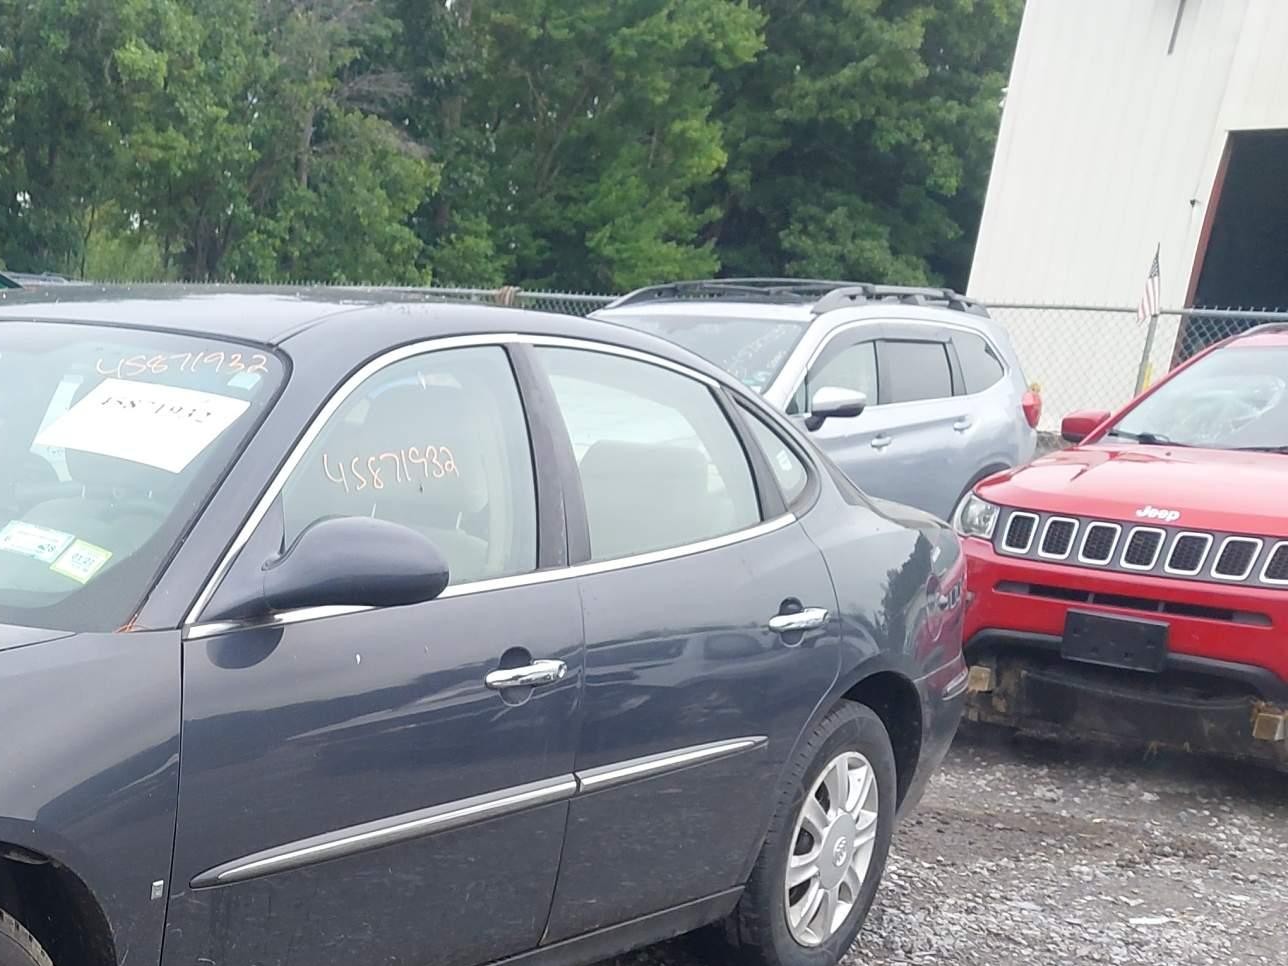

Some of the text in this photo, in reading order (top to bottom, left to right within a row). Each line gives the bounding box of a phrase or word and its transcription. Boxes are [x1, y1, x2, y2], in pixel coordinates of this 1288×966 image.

[96, 351, 269, 379] 45871932
[322, 445, 461, 494] 45871932
[1135, 504, 1181, 522] Jeep
